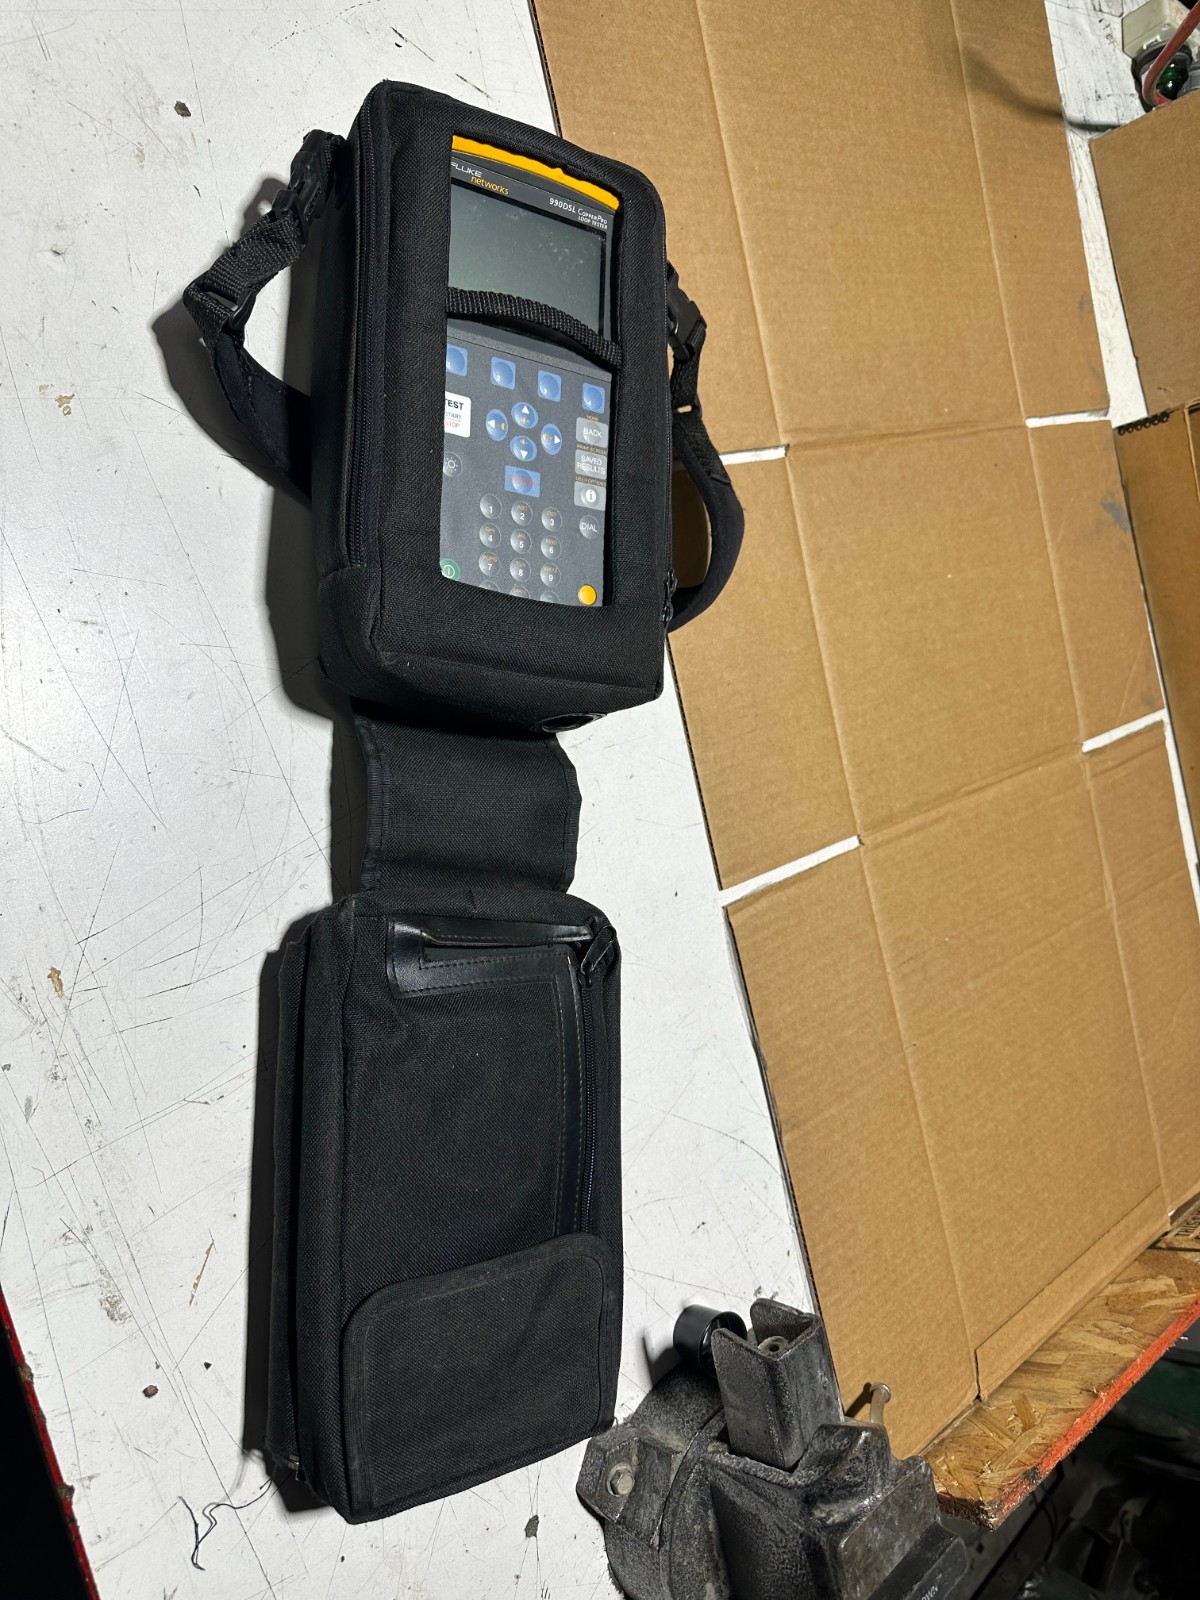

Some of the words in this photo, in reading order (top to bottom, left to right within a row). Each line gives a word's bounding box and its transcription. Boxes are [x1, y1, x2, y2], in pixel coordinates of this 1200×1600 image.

[471, 176, 509, 195] networks
[549, 197, 576, 213] 990DSL
[591, 220, 608, 230] TESTER
[583, 427, 602, 438] BACK
[581, 455, 603, 466] SAVED
[577, 461, 606, 475] RESULTS
[581, 522, 598, 533] DIAL
